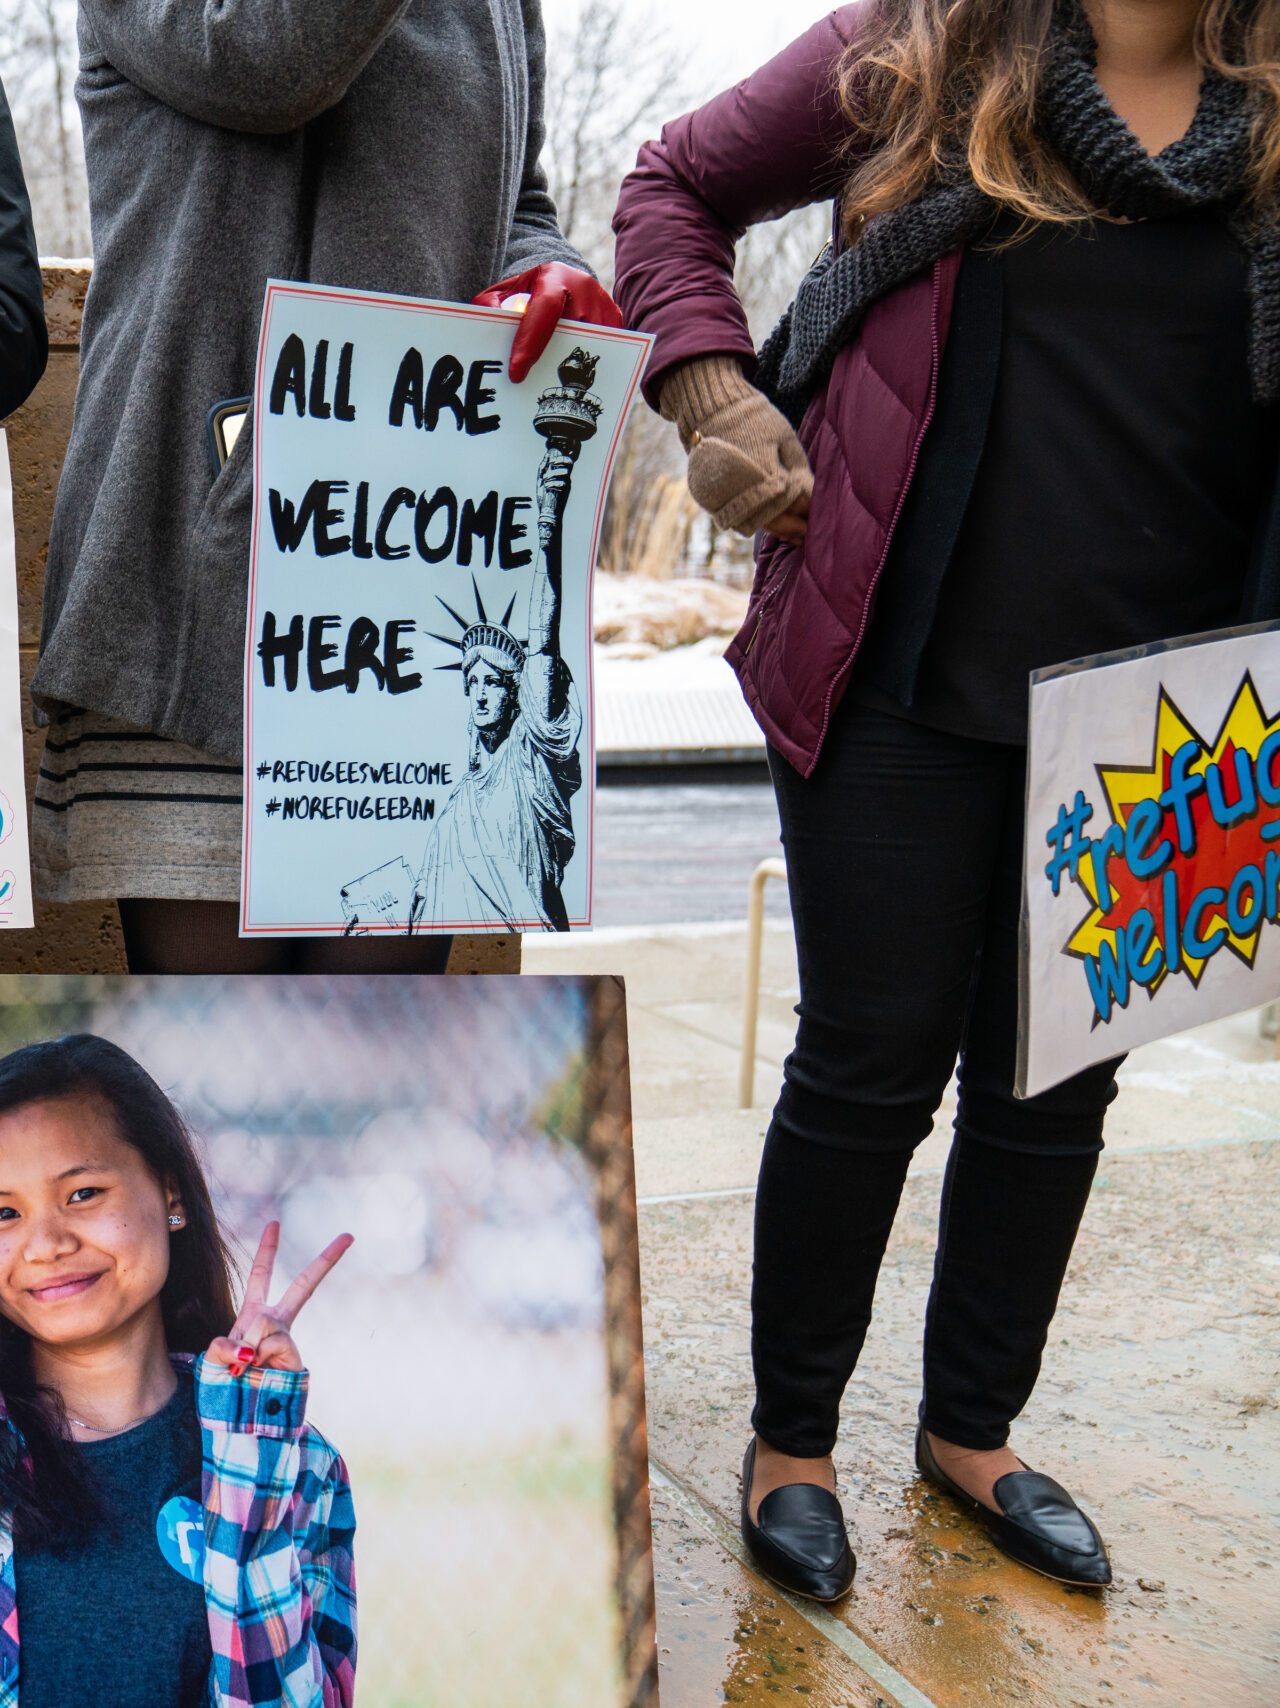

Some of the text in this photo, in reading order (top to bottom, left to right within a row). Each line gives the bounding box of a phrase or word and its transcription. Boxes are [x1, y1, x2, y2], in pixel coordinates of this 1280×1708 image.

[269, 332, 503, 436] ALL ARE
[268, 478, 533, 572] WELCOME
[257, 610, 423, 695] HERE
[256, 760, 453, 787] #REFUGEESWELCOME
[265, 794, 435, 822] #NOREFUGEEBAN
